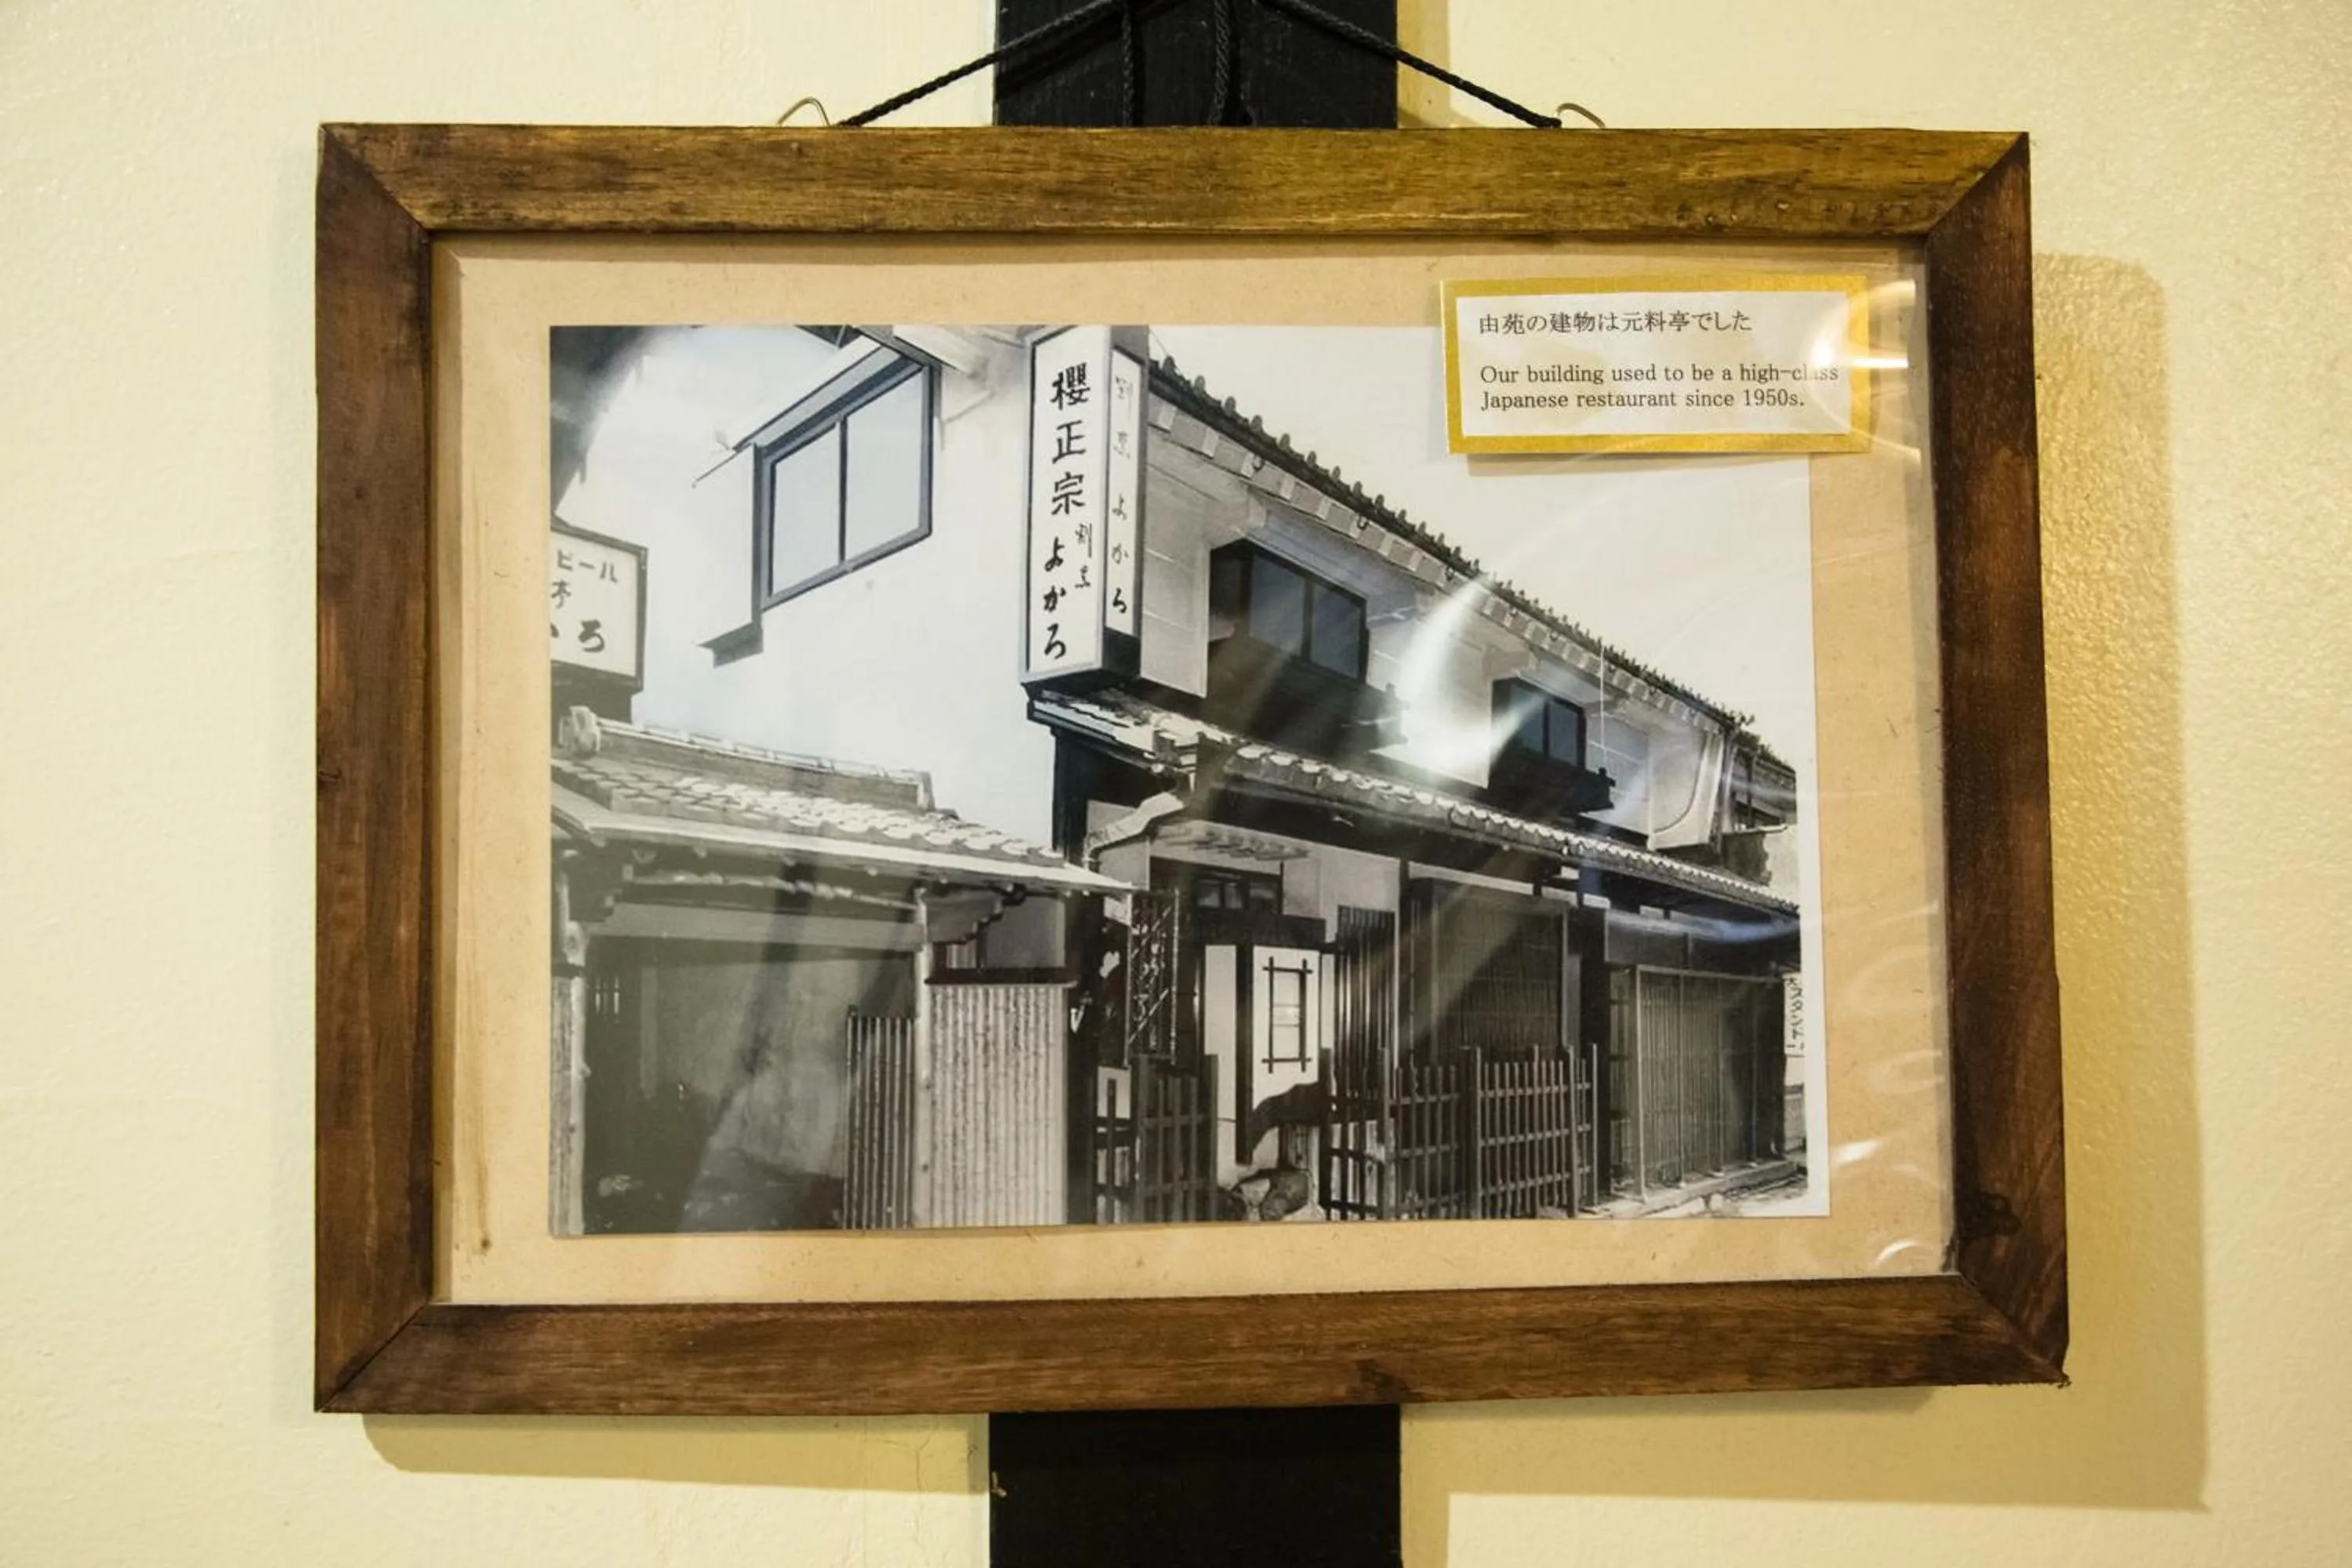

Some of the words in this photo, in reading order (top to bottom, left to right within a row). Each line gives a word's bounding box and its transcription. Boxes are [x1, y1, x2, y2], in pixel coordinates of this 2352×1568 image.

[1479, 310, 1752, 335] 由苑の建物は元料亭でした
[1480, 365, 1519, 383] Our
[1527, 364, 1605, 385] building
[1611, 364, 1657, 383] used
[1664, 366, 1684, 381] to
[1691, 364, 1715, 381] be
[1722, 367, 1733, 381] a
[1480, 391, 1569, 412] Japanese
[1576, 391, 1678, 408] restaurant
[1686, 389, 1734, 408] since
[1743, 389, 1805, 407] 1950s.
